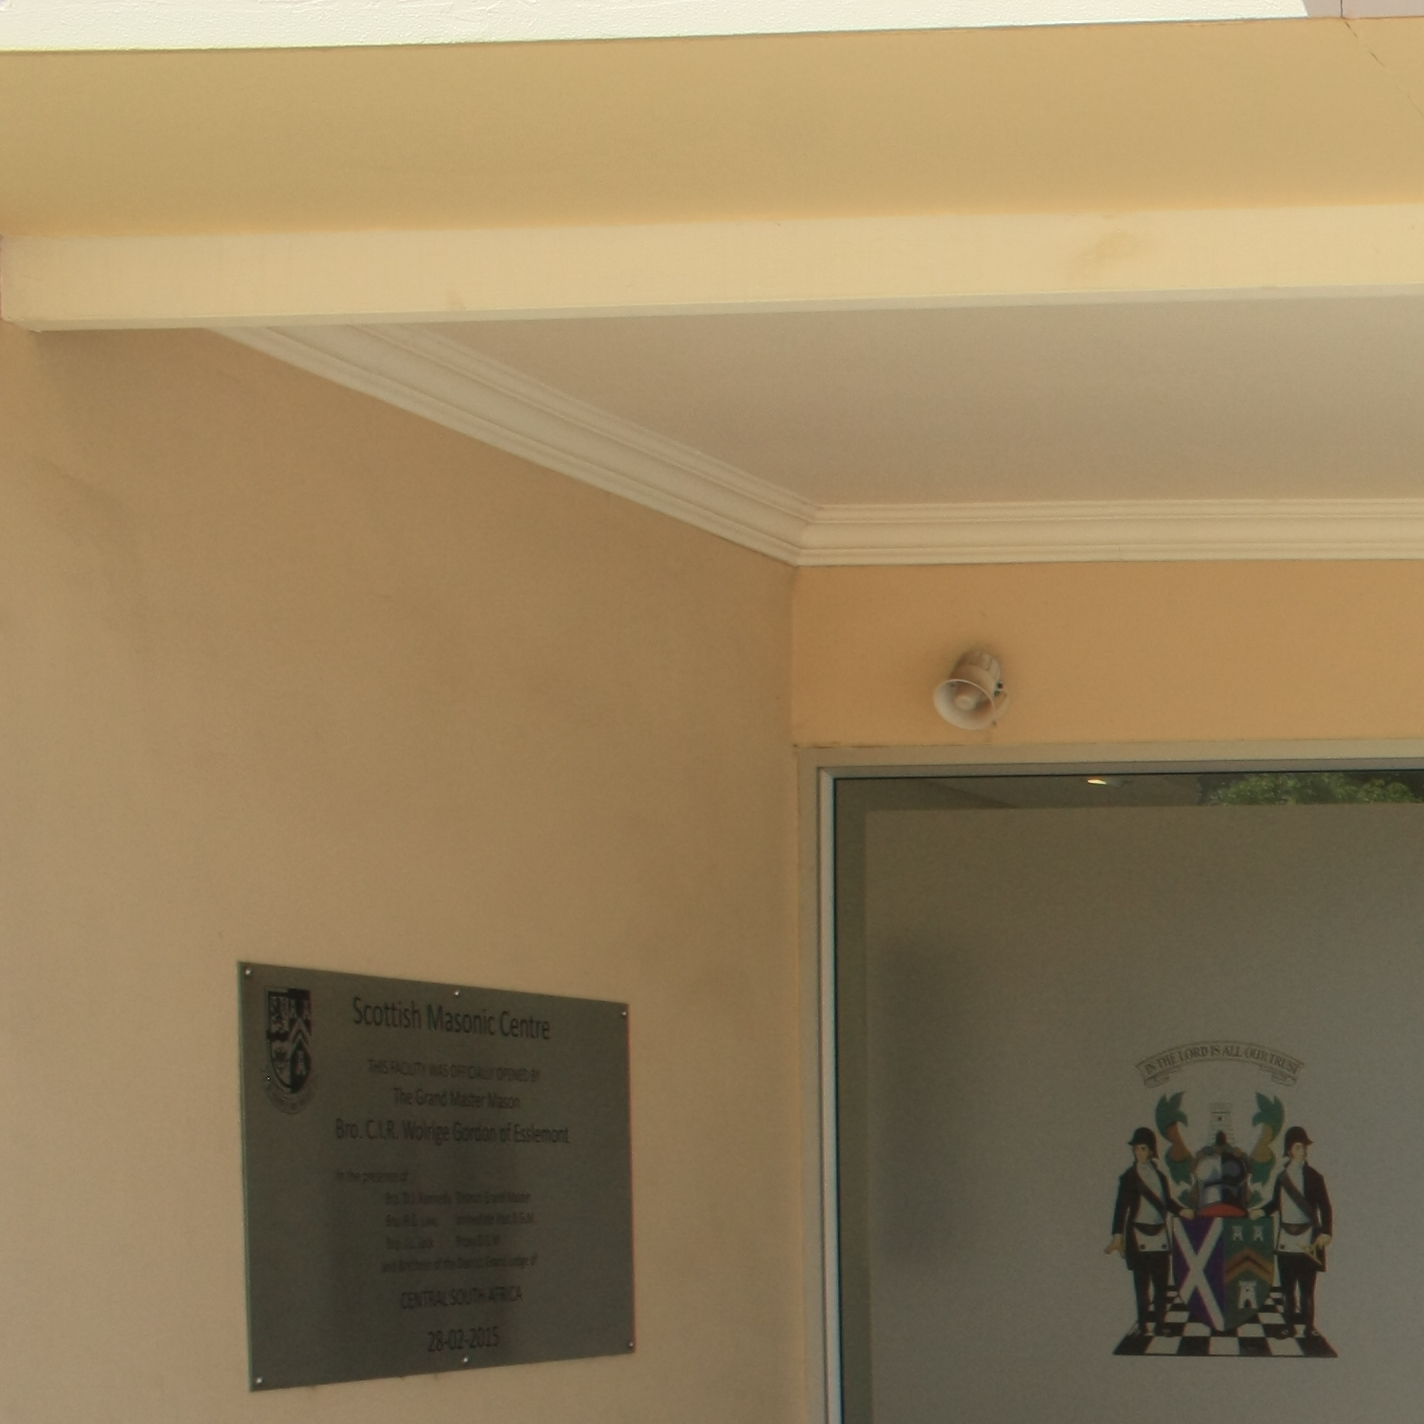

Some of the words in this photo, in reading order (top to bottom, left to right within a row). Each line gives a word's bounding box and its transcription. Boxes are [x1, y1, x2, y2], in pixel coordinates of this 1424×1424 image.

[352, 996, 422, 1030] Scottish
[426, 1003, 496, 1037] Masonic
[499, 1010, 551, 1040] Centre
[1157, 1054, 1177, 1068] THE
[1178, 1046, 1209, 1061] LORD
[1222, 1045, 1242, 1058] ALL
[1244, 1047, 1269, 1061] OUR
[1266, 1053, 1300, 1075] TRUST
[393, 1087, 413, 1106] The
[415, 1088, 447, 1107] Grand
[449, 1090, 485, 1108] Master
[486, 1092, 520, 1109] Mason
[336, 1117, 363, 1140] Bro.
[452, 1121, 496, 1143] Gordon
[499, 1122, 512, 1143] of
[400, 1290, 449, 1310] CENTRAL
[450, 1287, 485, 1306] SOUTH
[487, 1285, 523, 1303] AFRICA
[427, 1325, 500, 1352] 28-02-2015
